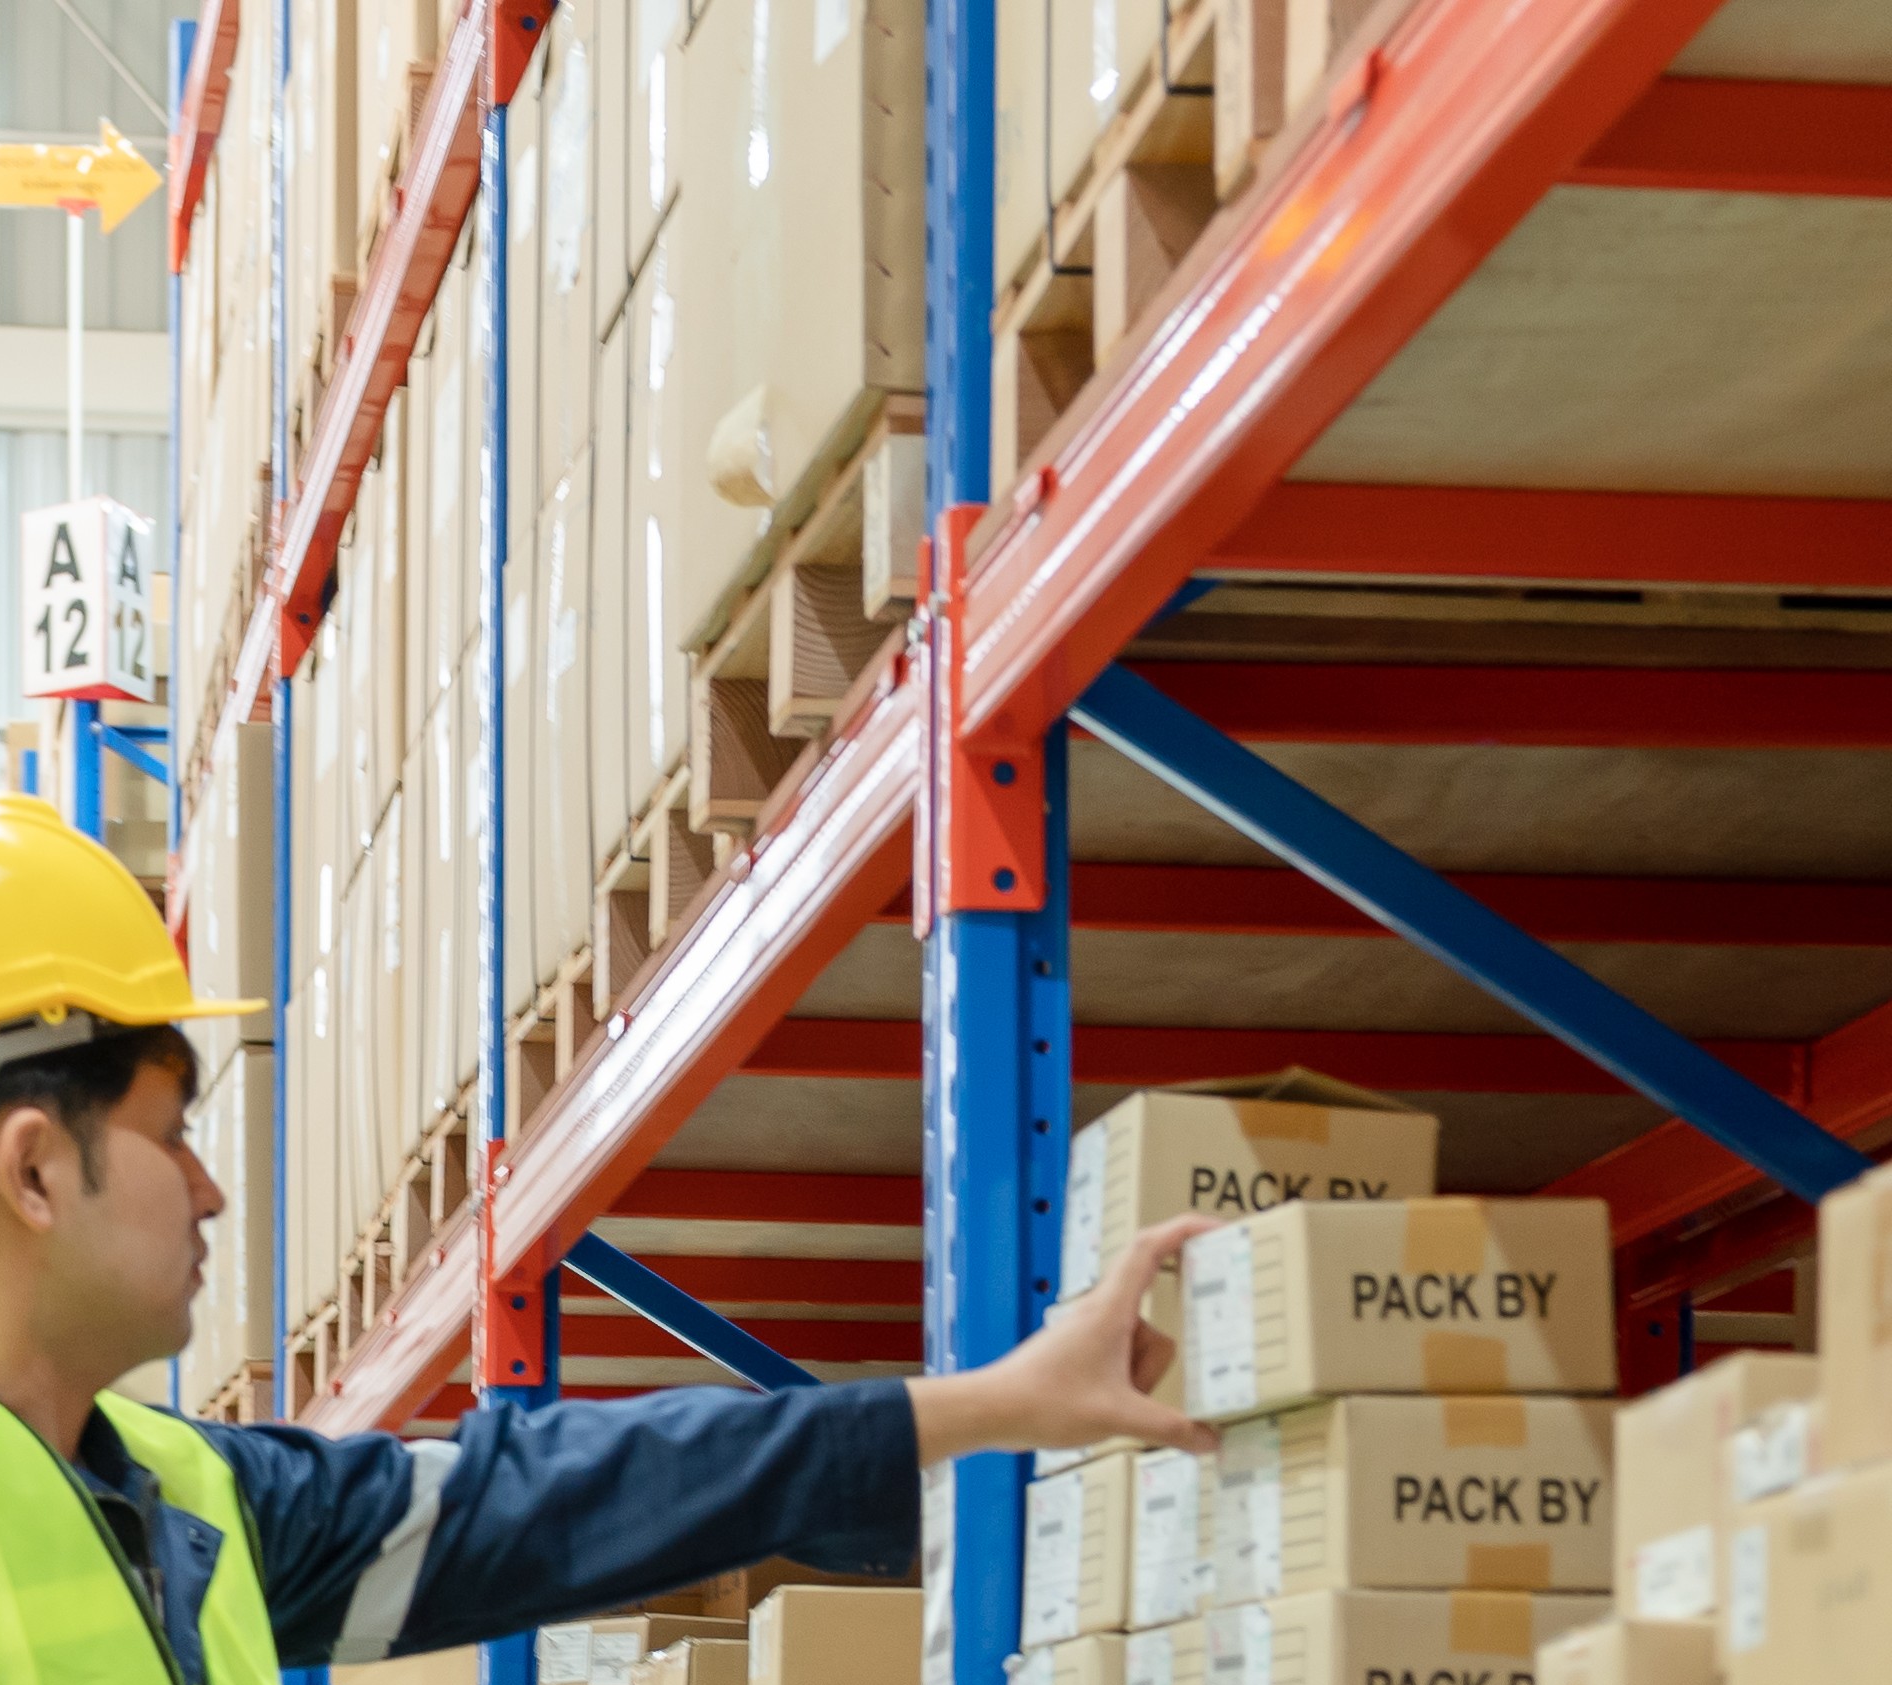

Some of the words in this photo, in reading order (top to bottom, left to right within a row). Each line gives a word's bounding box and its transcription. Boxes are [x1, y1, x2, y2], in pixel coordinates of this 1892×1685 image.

[44, 521, 82, 588] A
[118, 522, 143, 595] A
[35, 598, 89, 673] 12
[113, 602, 146, 681] 12
[1189, 1166, 1310, 1213] PACK
[1352, 1273, 1479, 1320] PACK
[1496, 1272, 1556, 1319] BY
[1394, 1475, 1521, 1524] PACK
[1538, 1478, 1600, 1524] BY
